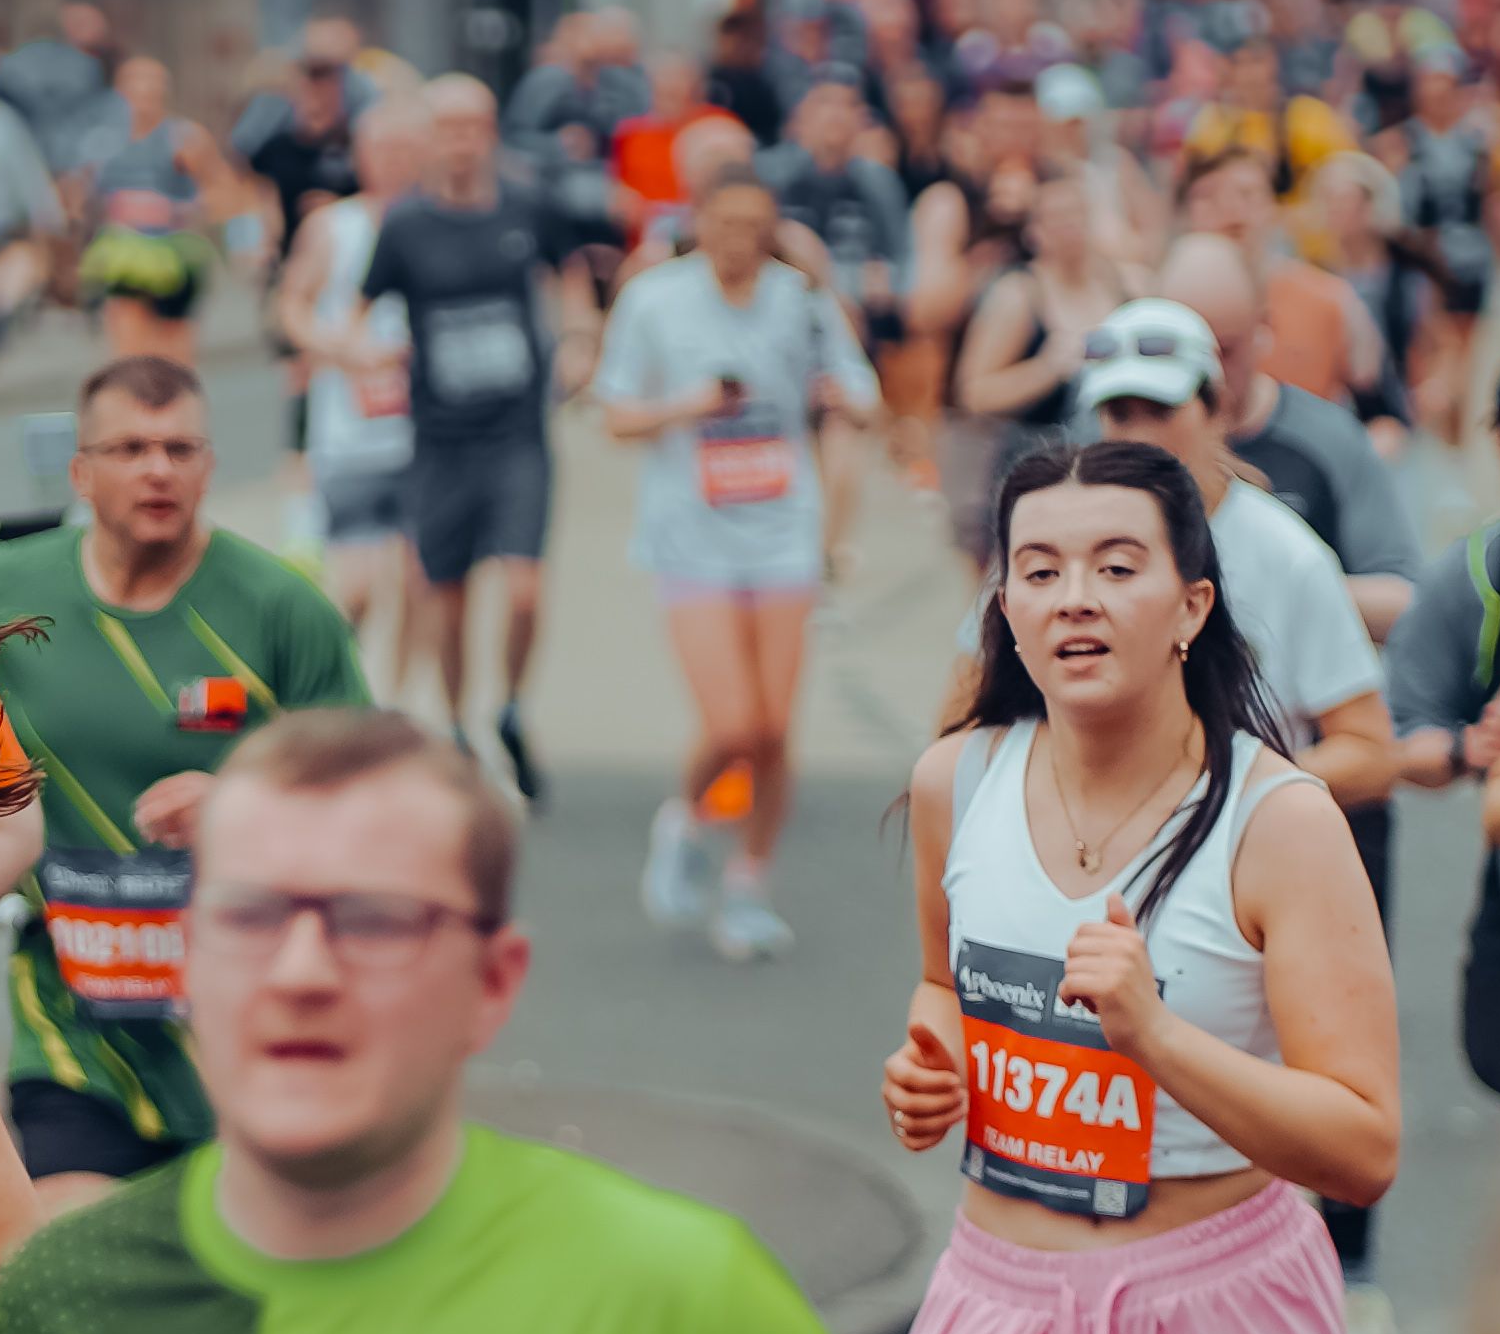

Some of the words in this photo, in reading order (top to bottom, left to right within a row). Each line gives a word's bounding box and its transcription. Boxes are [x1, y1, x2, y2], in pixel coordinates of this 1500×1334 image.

[970, 1039, 1142, 1132] 11374A
[984, 1124, 1026, 1159] TEAM
[1027, 1140, 1105, 1174] RELAY
